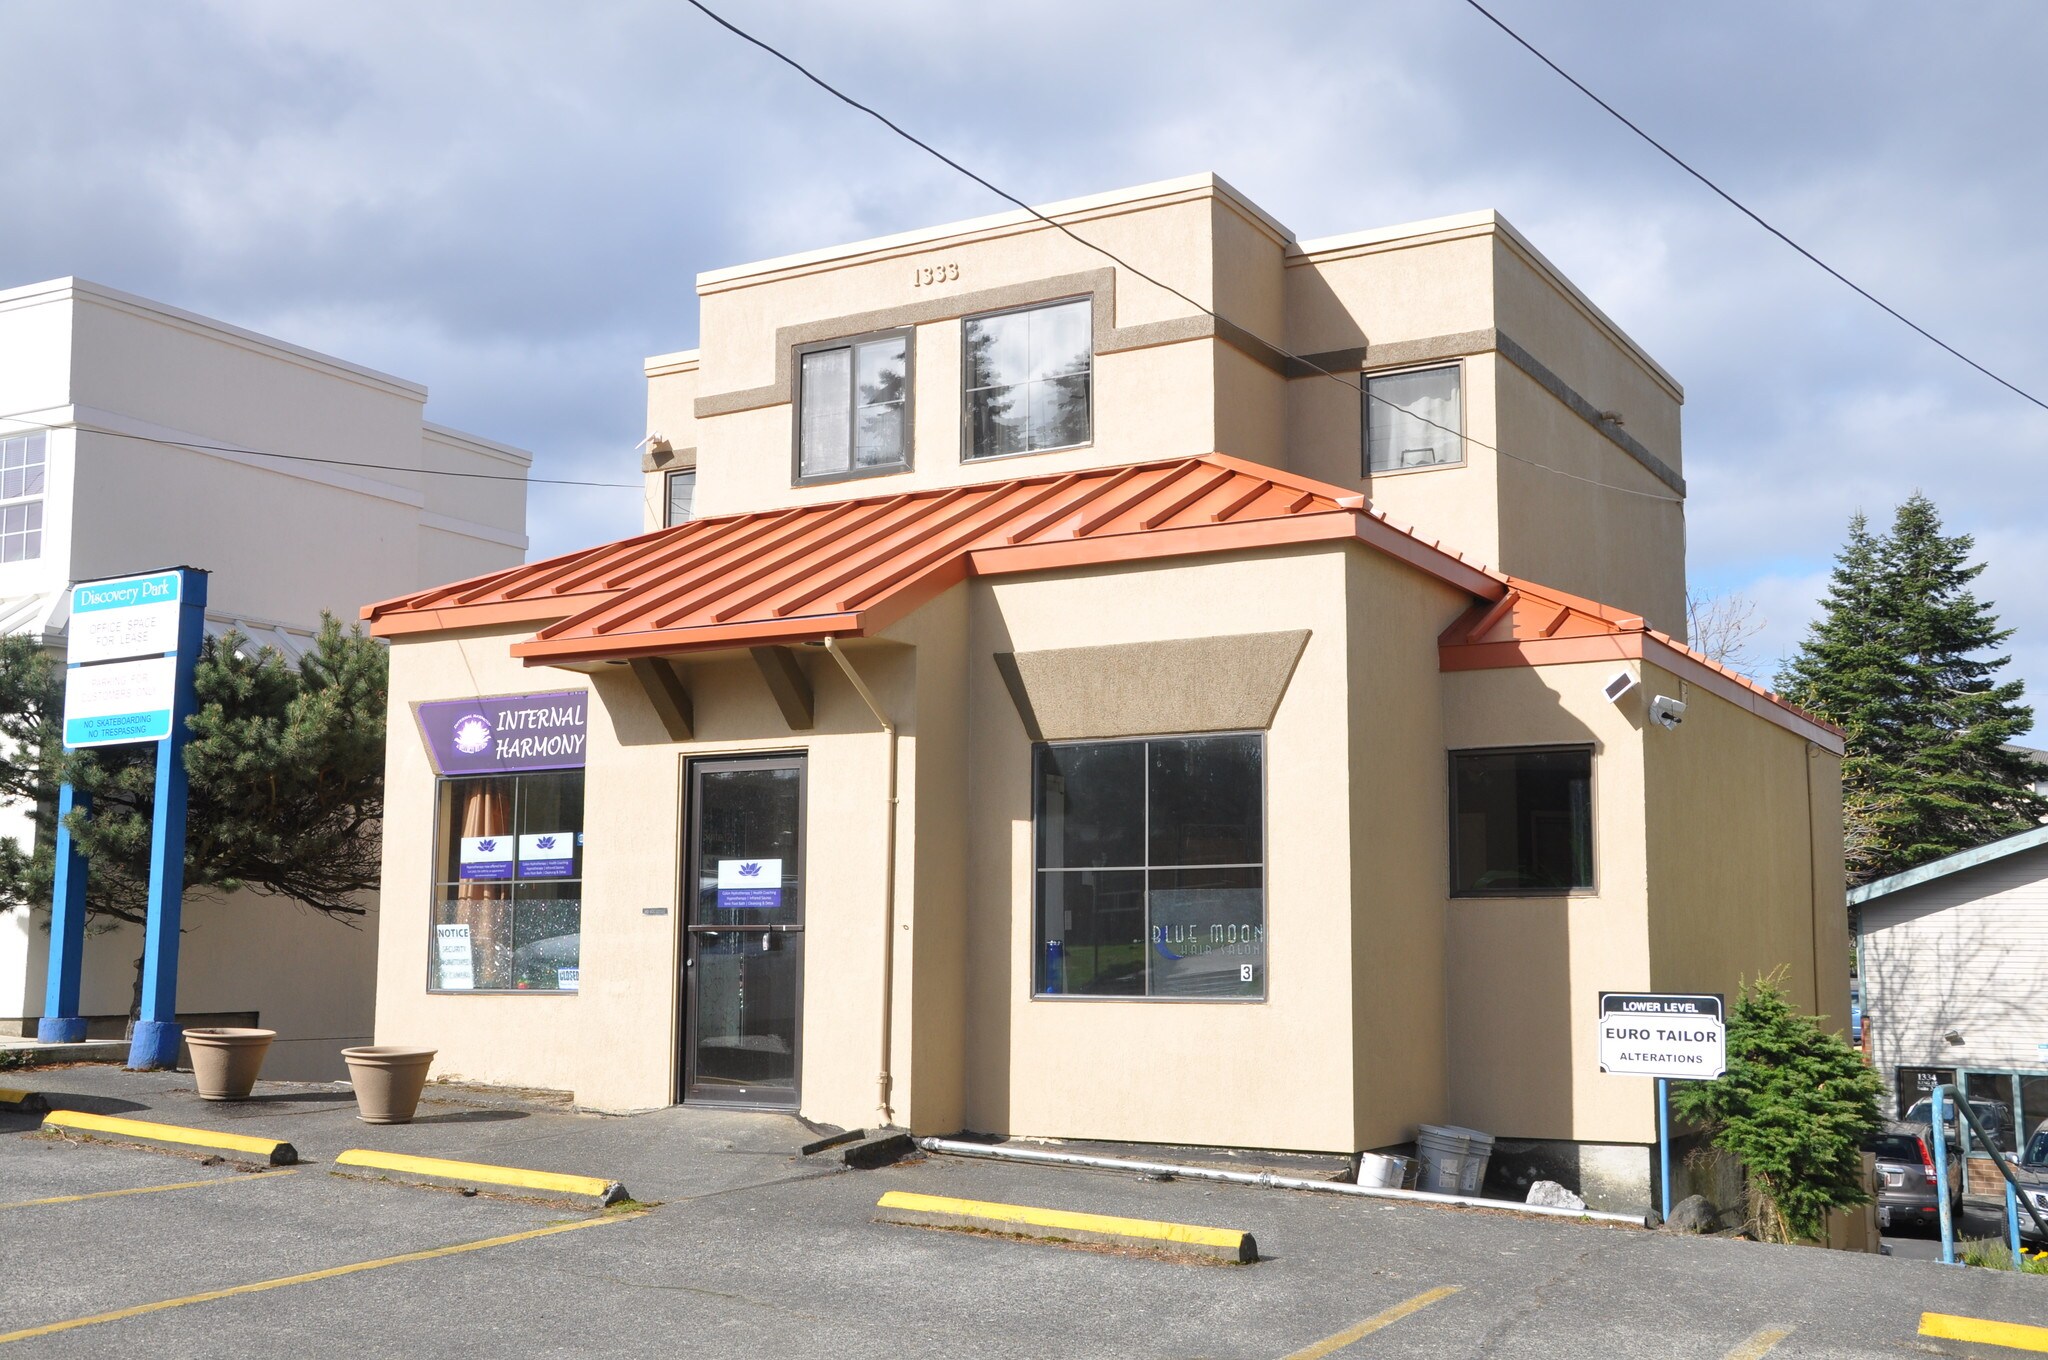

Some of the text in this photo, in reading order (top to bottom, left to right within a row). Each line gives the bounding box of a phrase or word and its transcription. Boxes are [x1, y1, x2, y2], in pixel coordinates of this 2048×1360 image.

[914, 262, 960, 287] 1333
[81, 579, 170, 606] Discovery Park
[90, 616, 157, 634] OFFICE SPACE
[96, 631, 148, 646] FOR LEASE
[92, 676, 126, 688] PARKING
[84, 714, 152, 728] NO SKATEBOARDING
[496, 704, 584, 732] INTERNAL
[88, 726, 146, 738] NO TRESPASSING
[496, 734, 585, 760] HARMONY
[438, 928, 468, 938] NOTICE
[1152, 924, 1263, 943] BLUE MOON
[560, 970, 579, 981] CLOSED
[1242, 966, 1251, 980] 3
[1622, 1002, 1698, 1012] LOWER LEVEL
[1606, 1028, 1716, 1042] EURO TAILOR
[1620, 1052, 1702, 1064] ALTERATIONS
